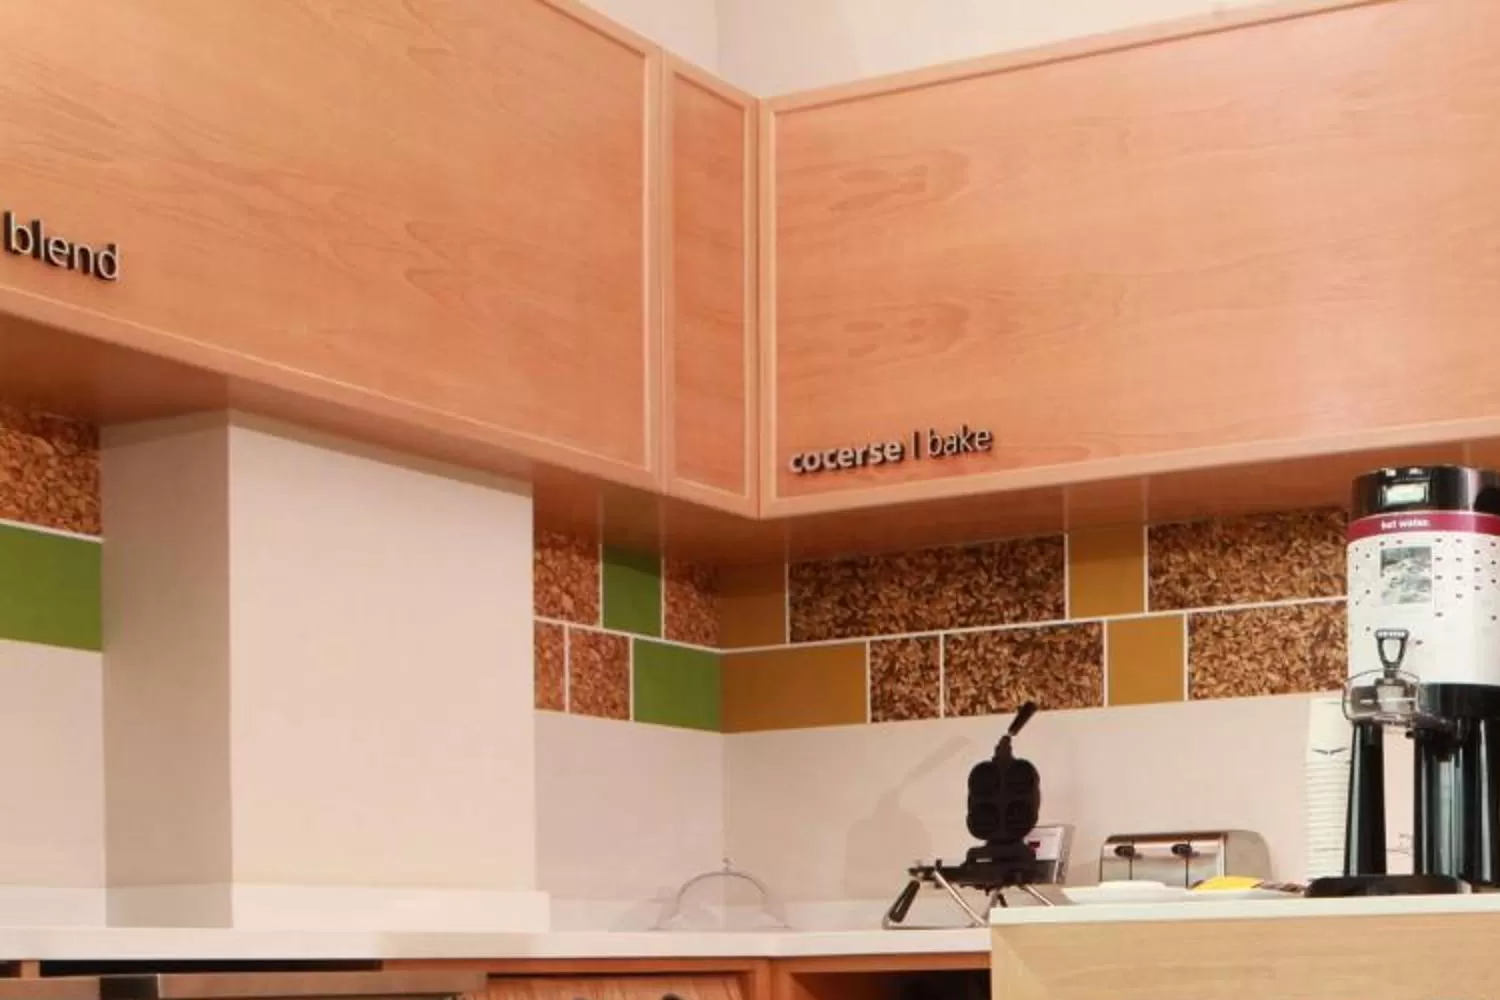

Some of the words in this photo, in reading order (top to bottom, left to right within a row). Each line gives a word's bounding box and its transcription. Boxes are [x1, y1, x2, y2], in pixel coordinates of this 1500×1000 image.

[3, 209, 121, 282] blend
[789, 439, 905, 474] cocerse
[927, 424, 993, 459] bake
